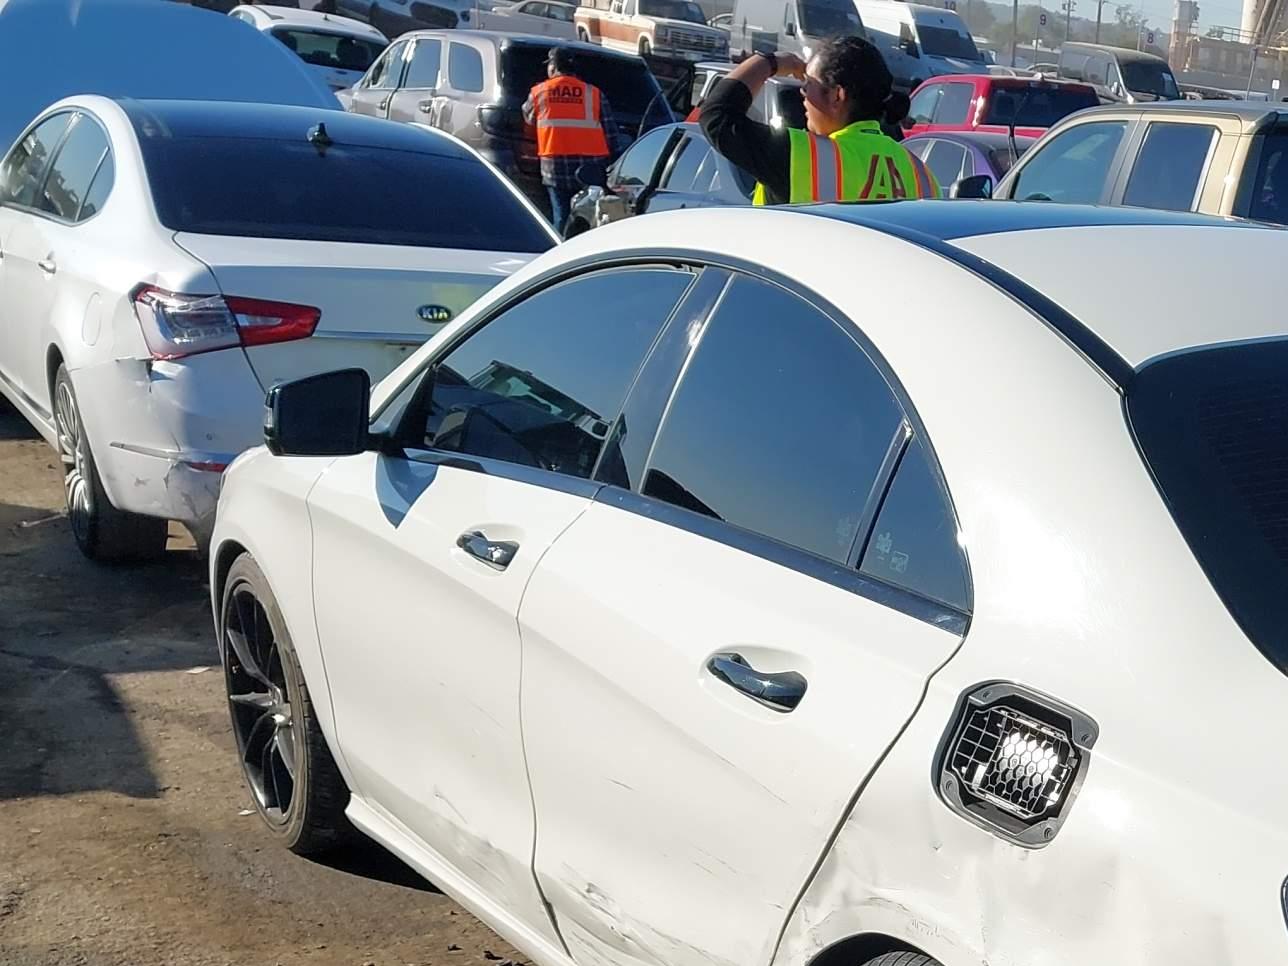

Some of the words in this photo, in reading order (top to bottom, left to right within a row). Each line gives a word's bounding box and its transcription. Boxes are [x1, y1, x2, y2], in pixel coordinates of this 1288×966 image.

[944, 1, 957, 10] 10
[1039, 14, 1047, 25] 9
[1146, 32, 1154, 43] 8
[549, 86, 583, 98] MAD
[421, 307, 448, 320] KIA
